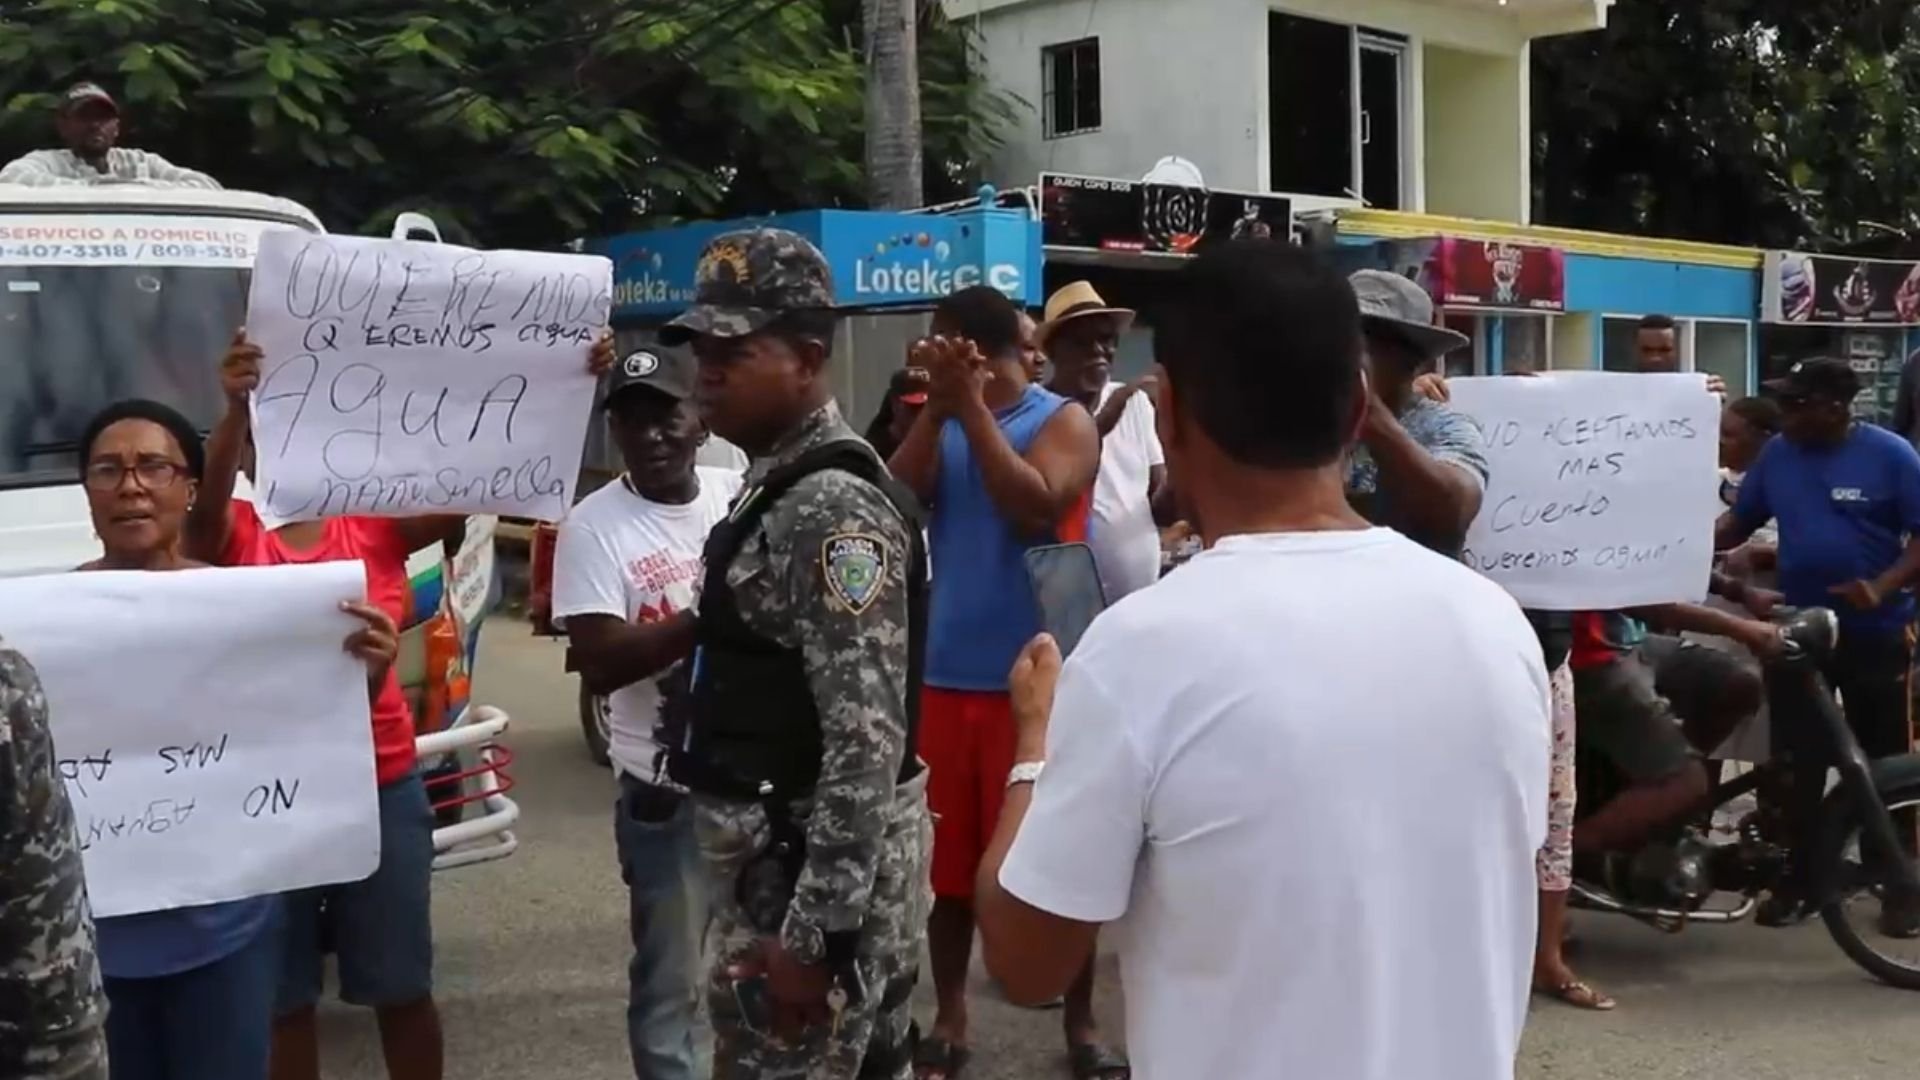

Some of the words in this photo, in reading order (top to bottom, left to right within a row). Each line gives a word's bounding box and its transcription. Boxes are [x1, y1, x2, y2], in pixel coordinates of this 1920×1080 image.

[0, 226, 105, 240] SERVICIO
[112, 228, 128, 241] A
[612, 272, 668, 304] oteka
[855, 260, 951, 295] Loteka
[1557, 452, 1625, 481] MAS
[158, 732, 229, 775] MAS
[242, 778, 299, 819] NO
